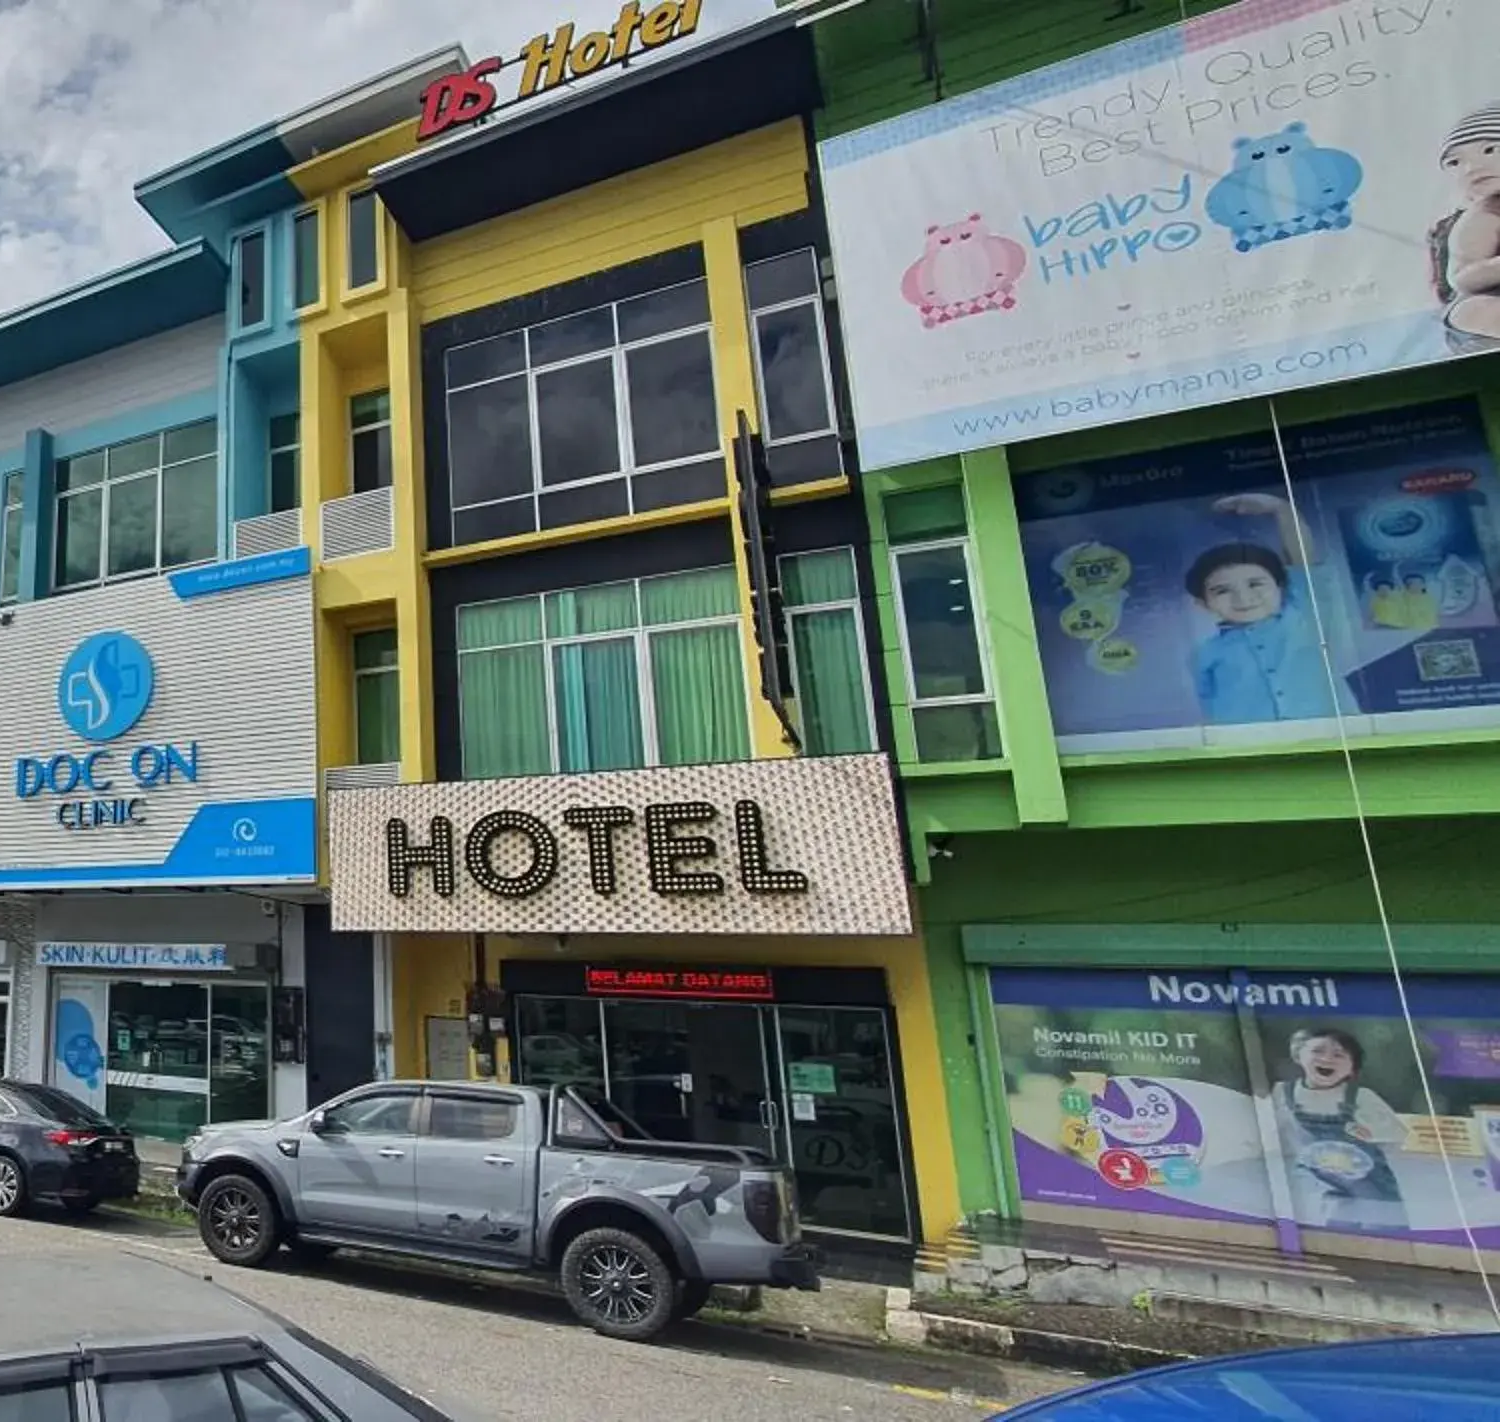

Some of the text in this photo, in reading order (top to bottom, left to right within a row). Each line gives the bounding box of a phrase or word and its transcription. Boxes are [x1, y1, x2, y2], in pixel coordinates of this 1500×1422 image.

[416, 0, 701, 141] DS Hotel
[979, 0, 1453, 153] Trendy! Quality.
[1039, 60, 1392, 177] Best Prices.
[1023, 173, 1192, 248] baby
[15, 740, 198, 800] DOC ON
[58, 798, 147, 829] CLINIC
[386, 799, 808, 899] HOTEL
[590, 970, 767, 989] SELAMAT DATANG
[1148, 974, 1340, 1008] Novamil
[1033, 1026, 1121, 1047] Novamil
[1127, 1030, 1169, 1048] KID
